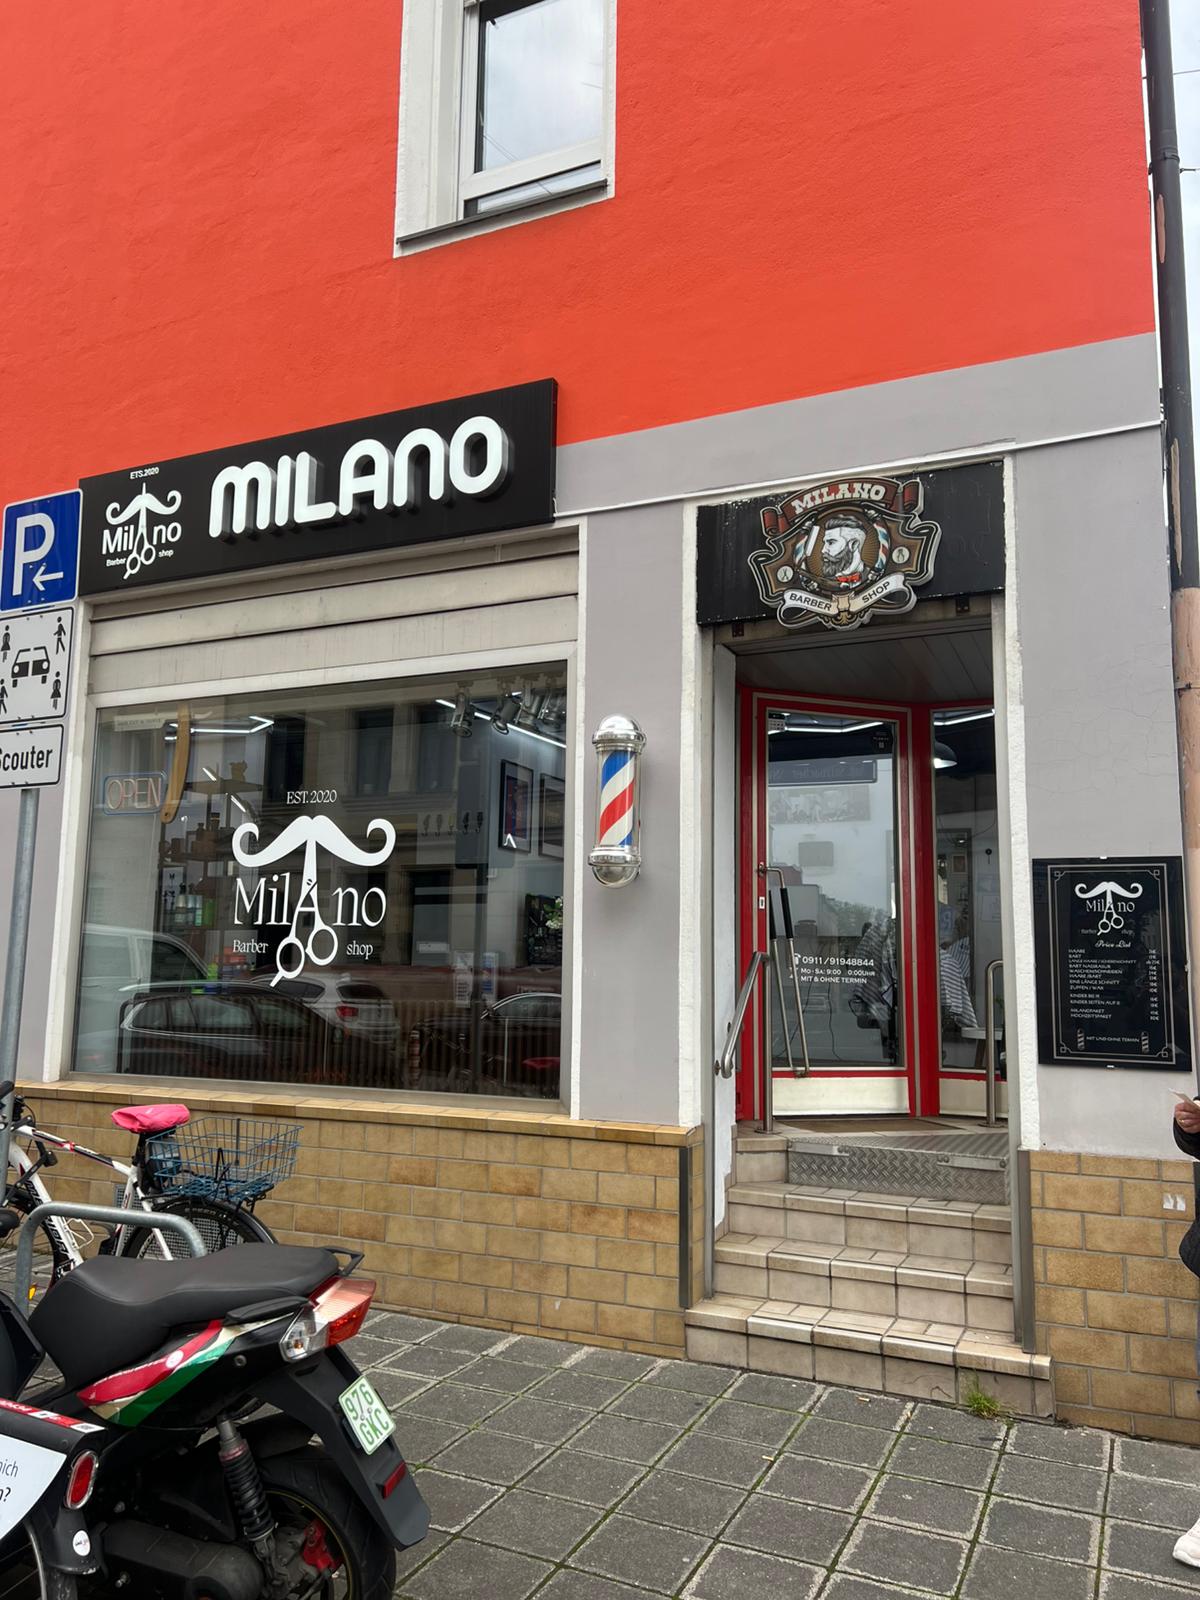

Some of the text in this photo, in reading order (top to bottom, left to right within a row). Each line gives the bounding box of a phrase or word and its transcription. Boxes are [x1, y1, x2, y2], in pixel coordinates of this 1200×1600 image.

[129, 466, 160, 480] ETS.2020
[209, 415, 506, 538] MILANO
[791, 482, 886, 515] MILANO
[12, 512, 56, 597] P
[158, 549, 174, 558] shop
[789, 581, 890, 612] BARBER SHOP
[107, 777, 161, 810] OPEN
[232, 939, 374, 960] Barber shop
[802, 956, 874, 967] 0911/91948844
[344, 1383, 374, 1421] 976
[360, 1408, 389, 1446] GKC
